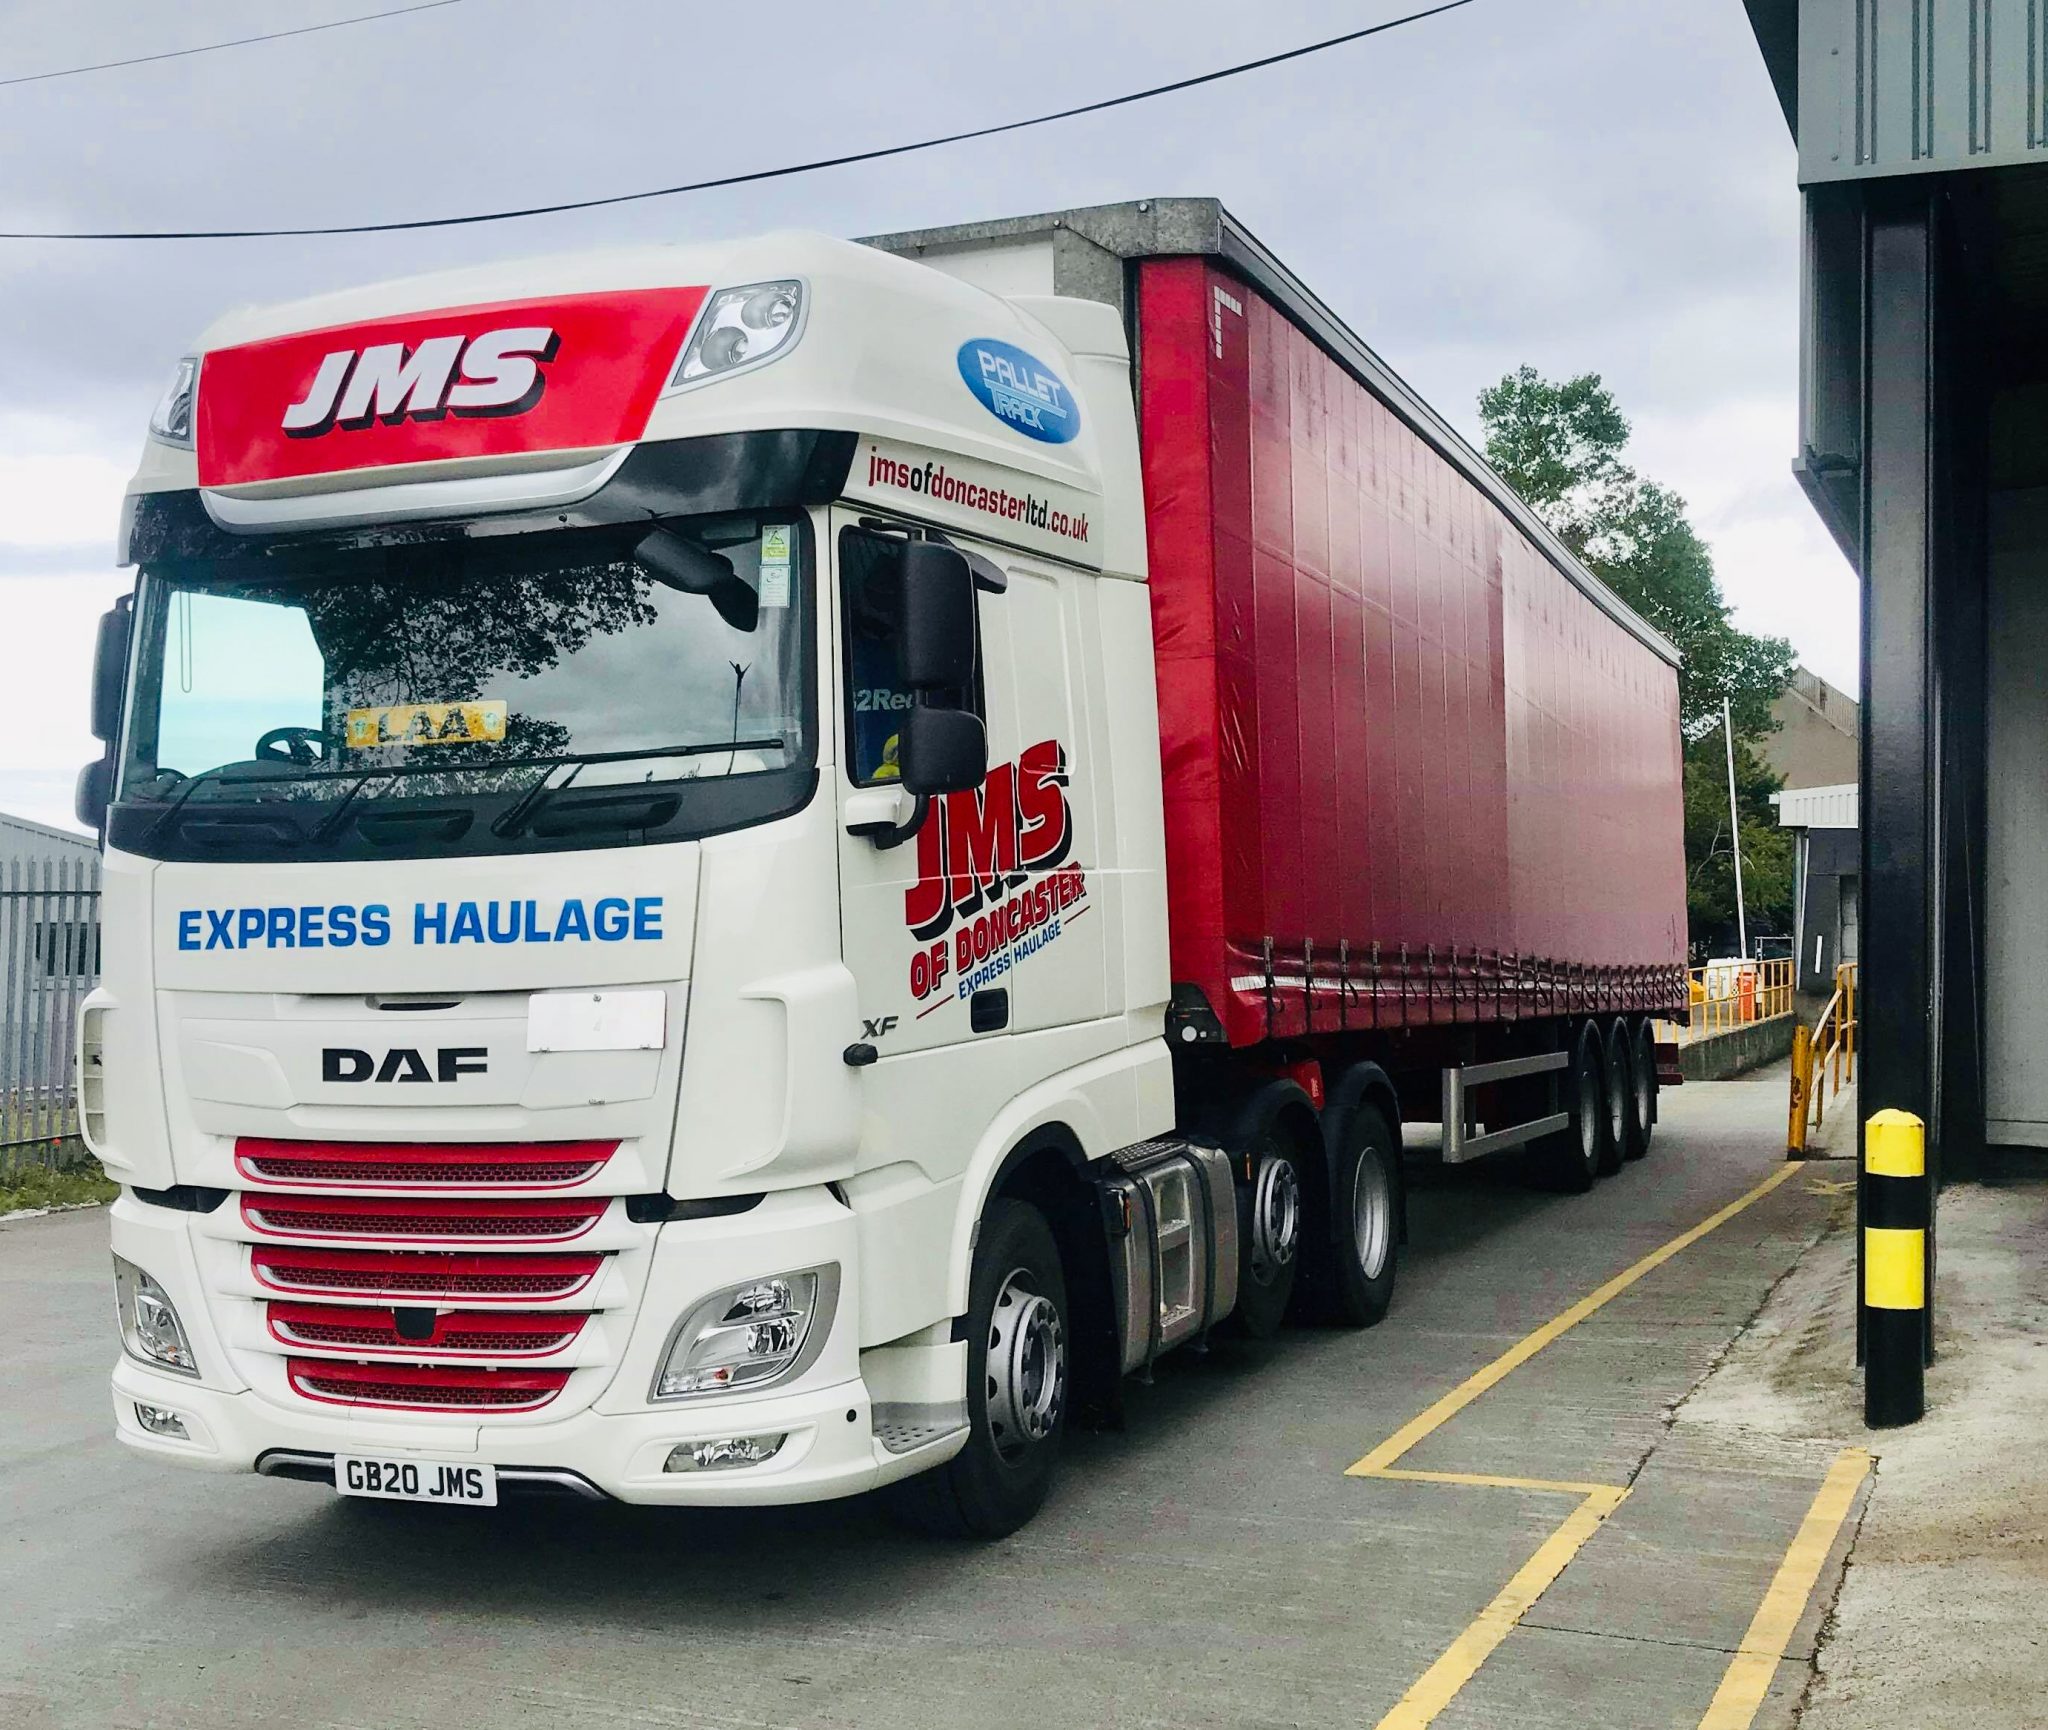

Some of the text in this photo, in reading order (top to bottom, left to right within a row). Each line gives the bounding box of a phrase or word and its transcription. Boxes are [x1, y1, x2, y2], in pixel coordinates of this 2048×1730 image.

[281, 327, 561, 438] JMS
[977, 349, 1060, 406] PALLET
[983, 378, 1067, 430] TRACK
[868, 446, 1089, 542] jmsofdoncasterltd.co.uk
[905, 740, 1072, 941] JMS
[178, 897, 664, 951] EXPRESS HAULAGE
[910, 861, 1087, 1000] OF DONCASTER
[959, 920, 1062, 1000] EXPRESS HAULAGE
[861, 1015, 899, 1039] XF
[322, 1048, 488, 1083] DAF
[347, 1460, 484, 1499] GB20 JMS
